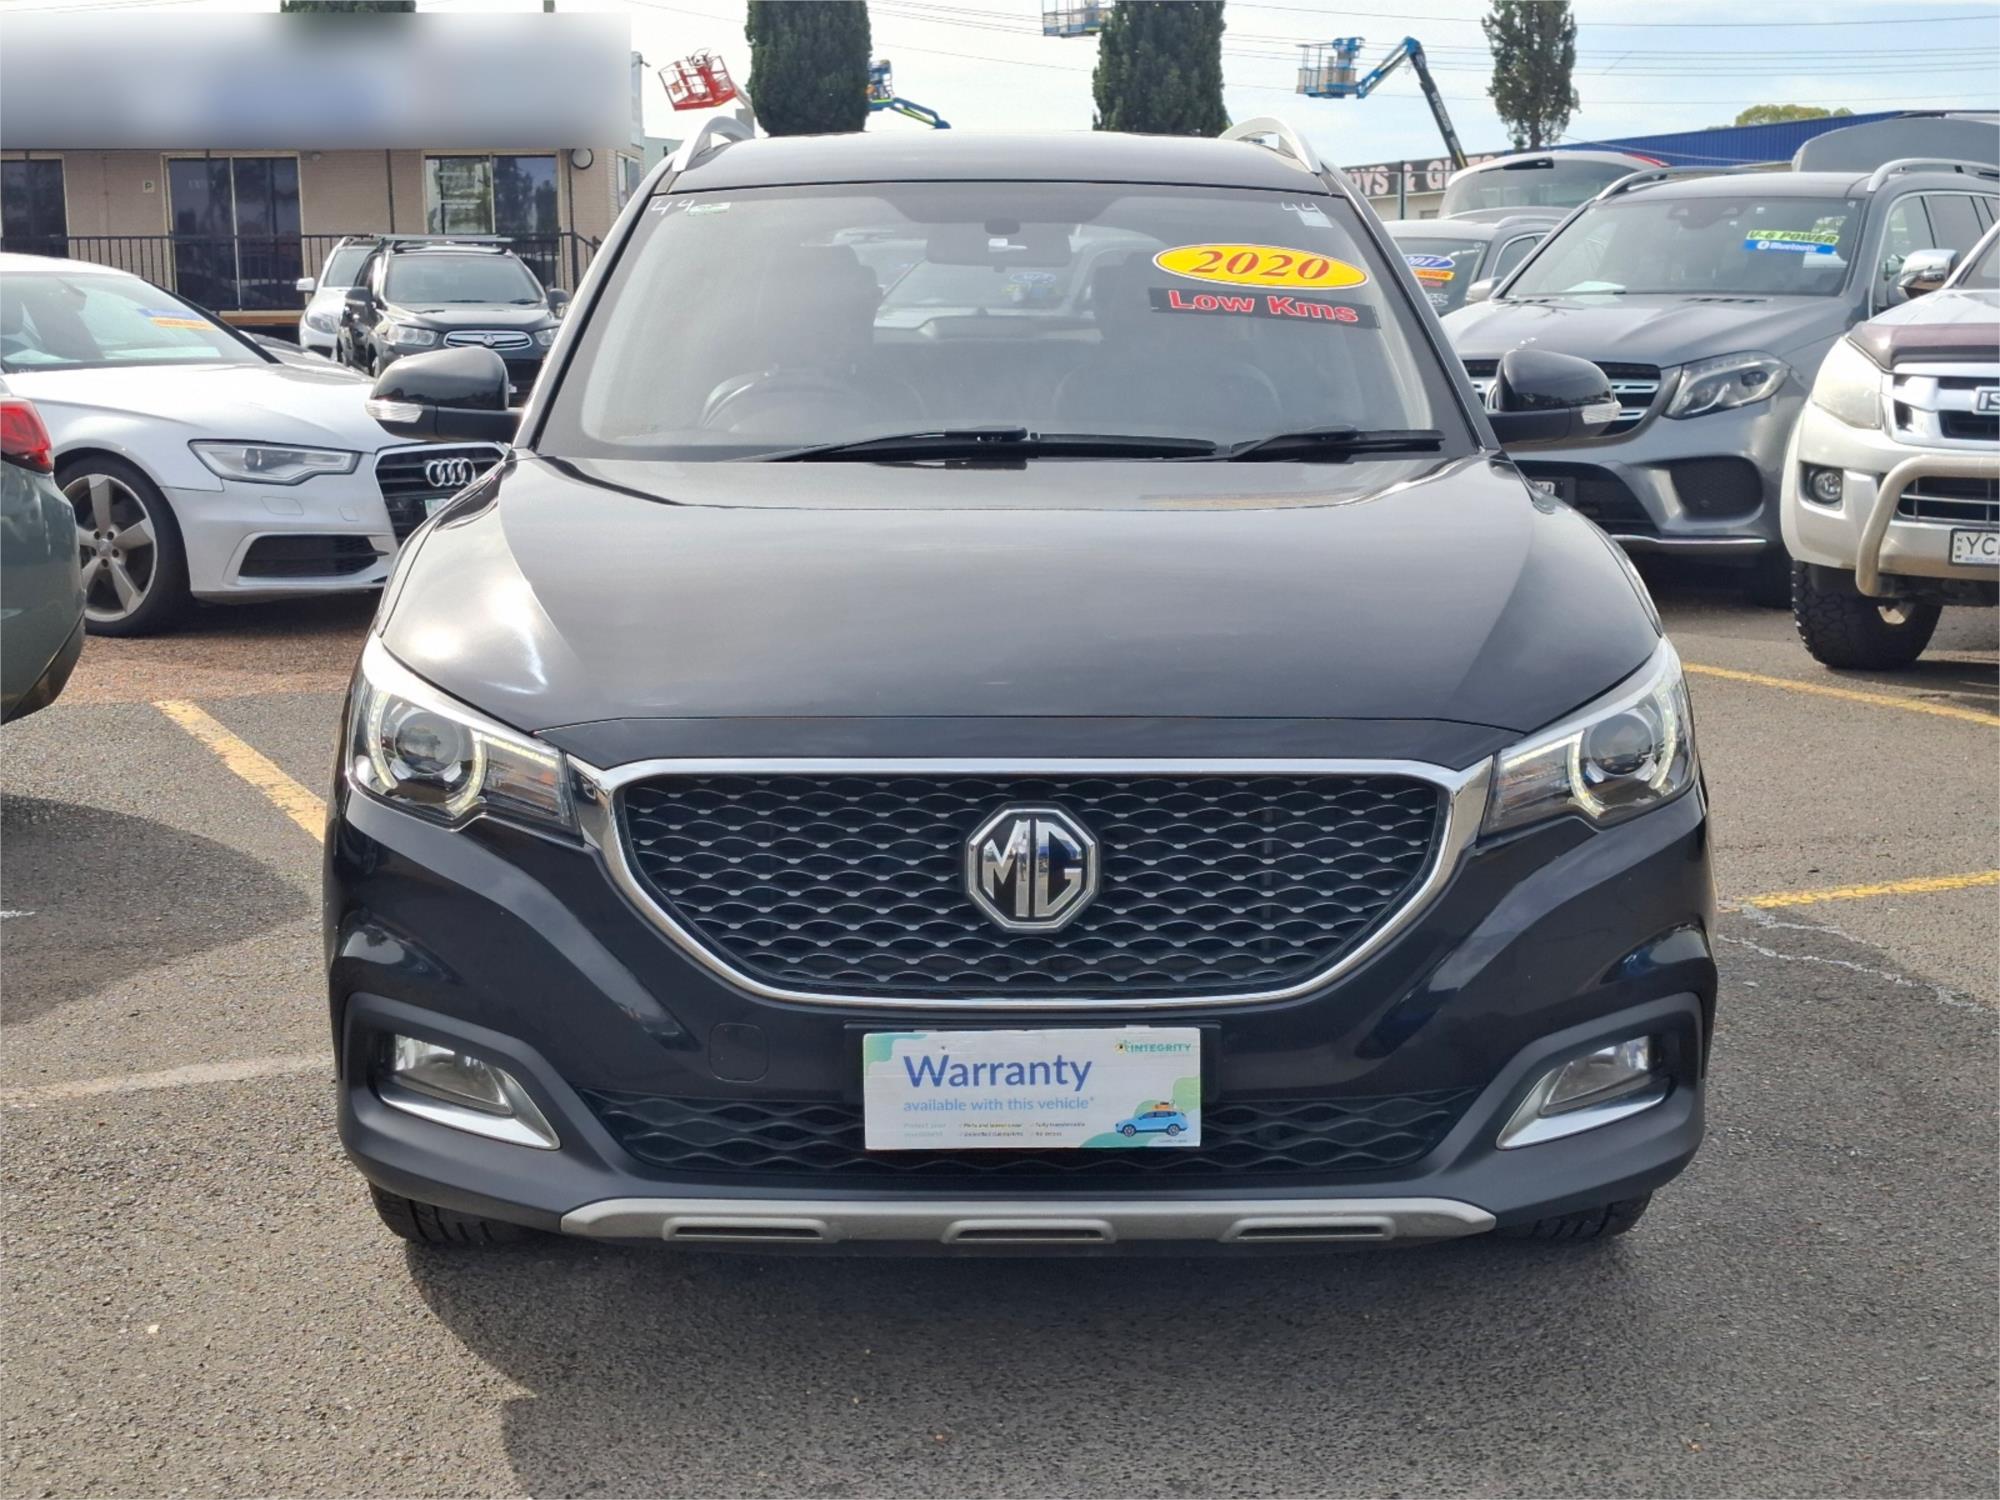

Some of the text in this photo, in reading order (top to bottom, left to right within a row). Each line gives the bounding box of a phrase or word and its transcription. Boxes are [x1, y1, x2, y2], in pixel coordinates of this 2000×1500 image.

[1778, 232, 1837, 244] POWER
[1189, 250, 1330, 280] 2020
[1167, 289, 1359, 323] Low Kms
[982, 818, 1083, 918] MG
[1130, 1043, 1192, 1053] INTEGRITY
[903, 1054, 1093, 1092] Warranty
[903, 1098, 967, 1112] available
[970, 1098, 1003, 1111] with
[1007, 1097, 1033, 1112] this
